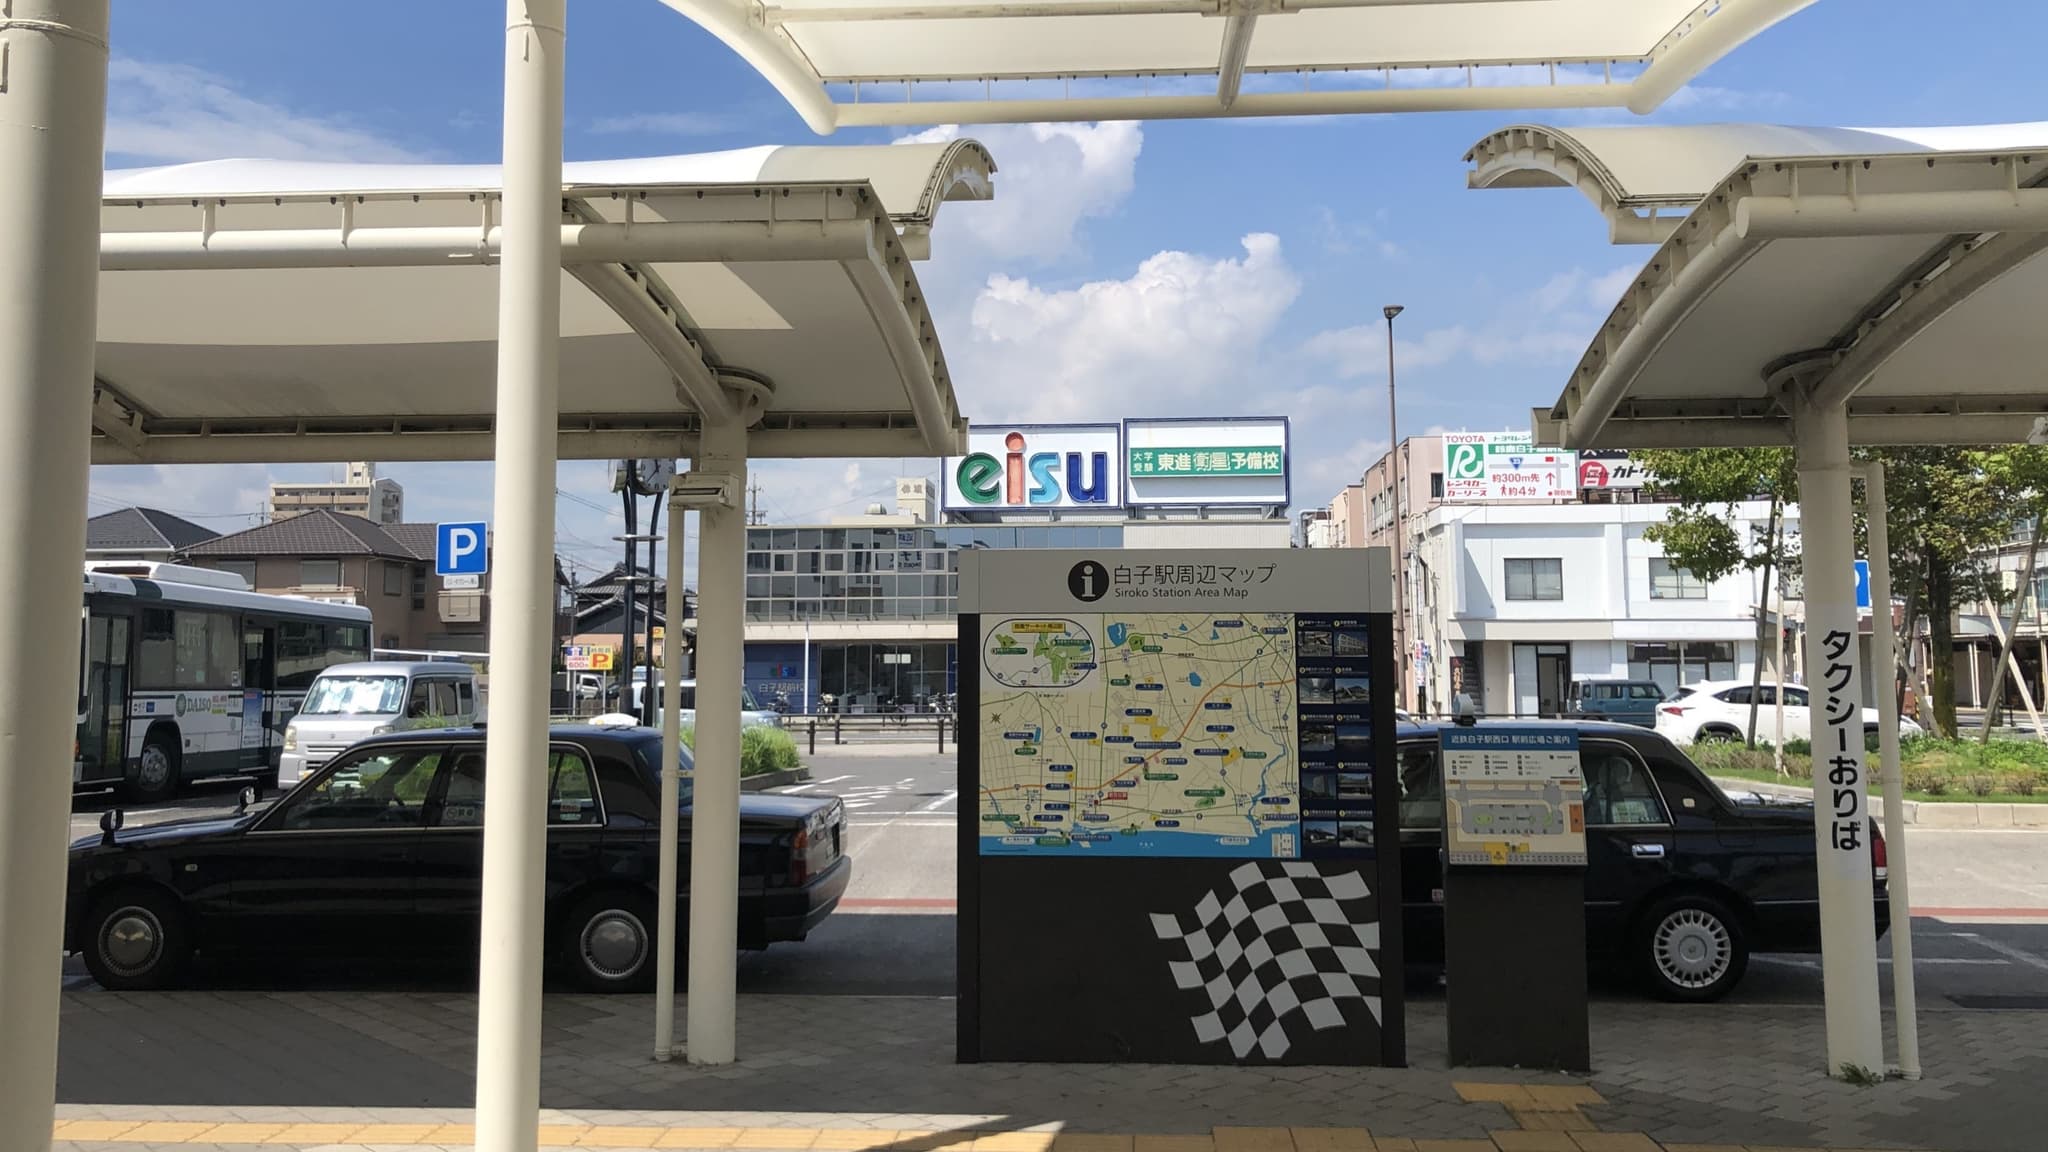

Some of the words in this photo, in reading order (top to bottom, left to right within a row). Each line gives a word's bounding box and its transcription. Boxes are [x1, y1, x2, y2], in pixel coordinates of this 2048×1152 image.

[1133, 452, 1153, 461] 大学
[1157, 451, 1279, 471] 東進衛星予備校
[957, 431, 1107, 504] eisu
[1492, 473, 1540, 482] 約300m先
[1508, 486, 1536, 496] 約4分
[450, 528, 477, 569] P
[1114, 563, 1277, 585] 白子駅周辺マップ
[1115, 587, 1149, 598] Siroko
[1152, 587, 1191, 598] Station
[1195, 587, 1220, 598] Area
[1223, 587, 1249, 600] Map
[592, 653, 609, 668] P
[186, 697, 211, 713] DAISO
[1823, 630, 1862, 850] タクシーおりば
